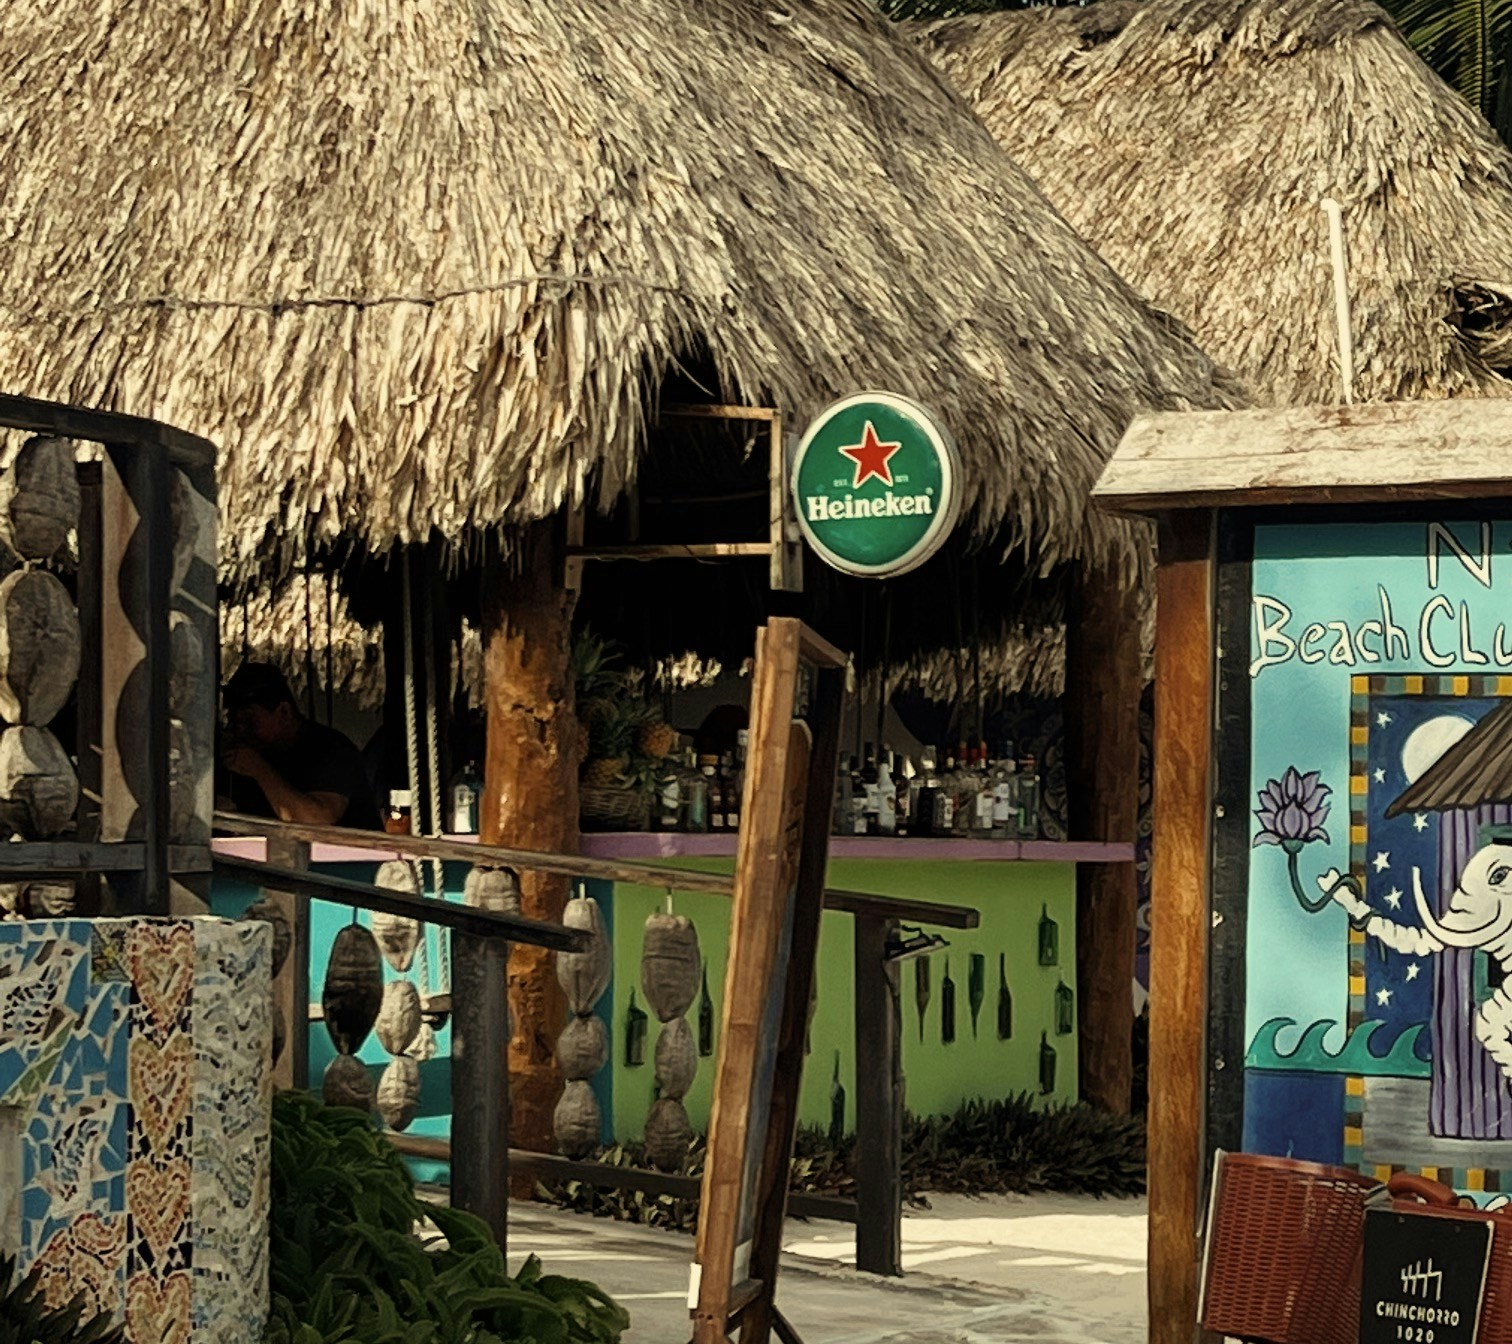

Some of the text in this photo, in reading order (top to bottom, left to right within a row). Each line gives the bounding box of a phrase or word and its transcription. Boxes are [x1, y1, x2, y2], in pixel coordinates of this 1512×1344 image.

[807, 490, 933, 521] Heineken
[1249, 583, 1410, 677] Beach
[1376, 1301, 1459, 1326] CHINCHORRO
[1397, 1325, 1434, 1344] 1020
